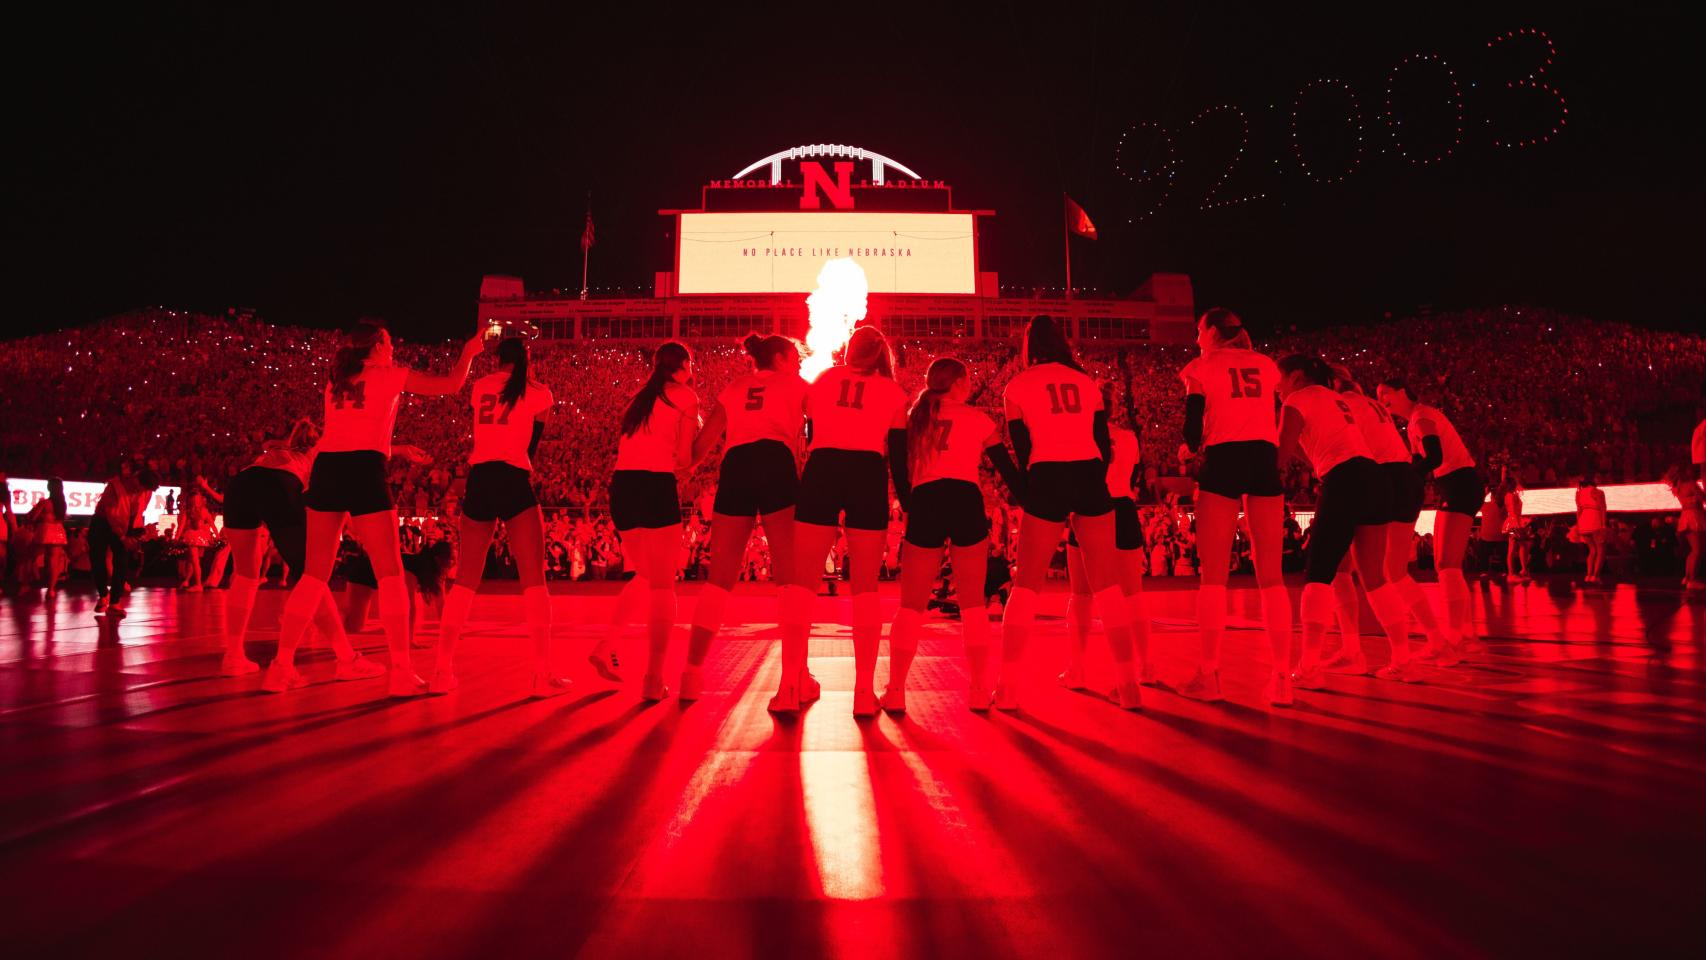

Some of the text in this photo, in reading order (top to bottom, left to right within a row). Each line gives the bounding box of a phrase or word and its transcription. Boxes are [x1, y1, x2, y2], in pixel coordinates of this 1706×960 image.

[710, 179, 794, 189] MEMORIAL
[800, 161, 854, 209] N
[743, 248, 912, 257] NO PLACE LIKE NEBRASKA
[836, 379, 866, 410] 11
[1228, 367, 1263, 398] 15
[744, 386, 766, 411] 5
[1045, 383, 1083, 414] 10
